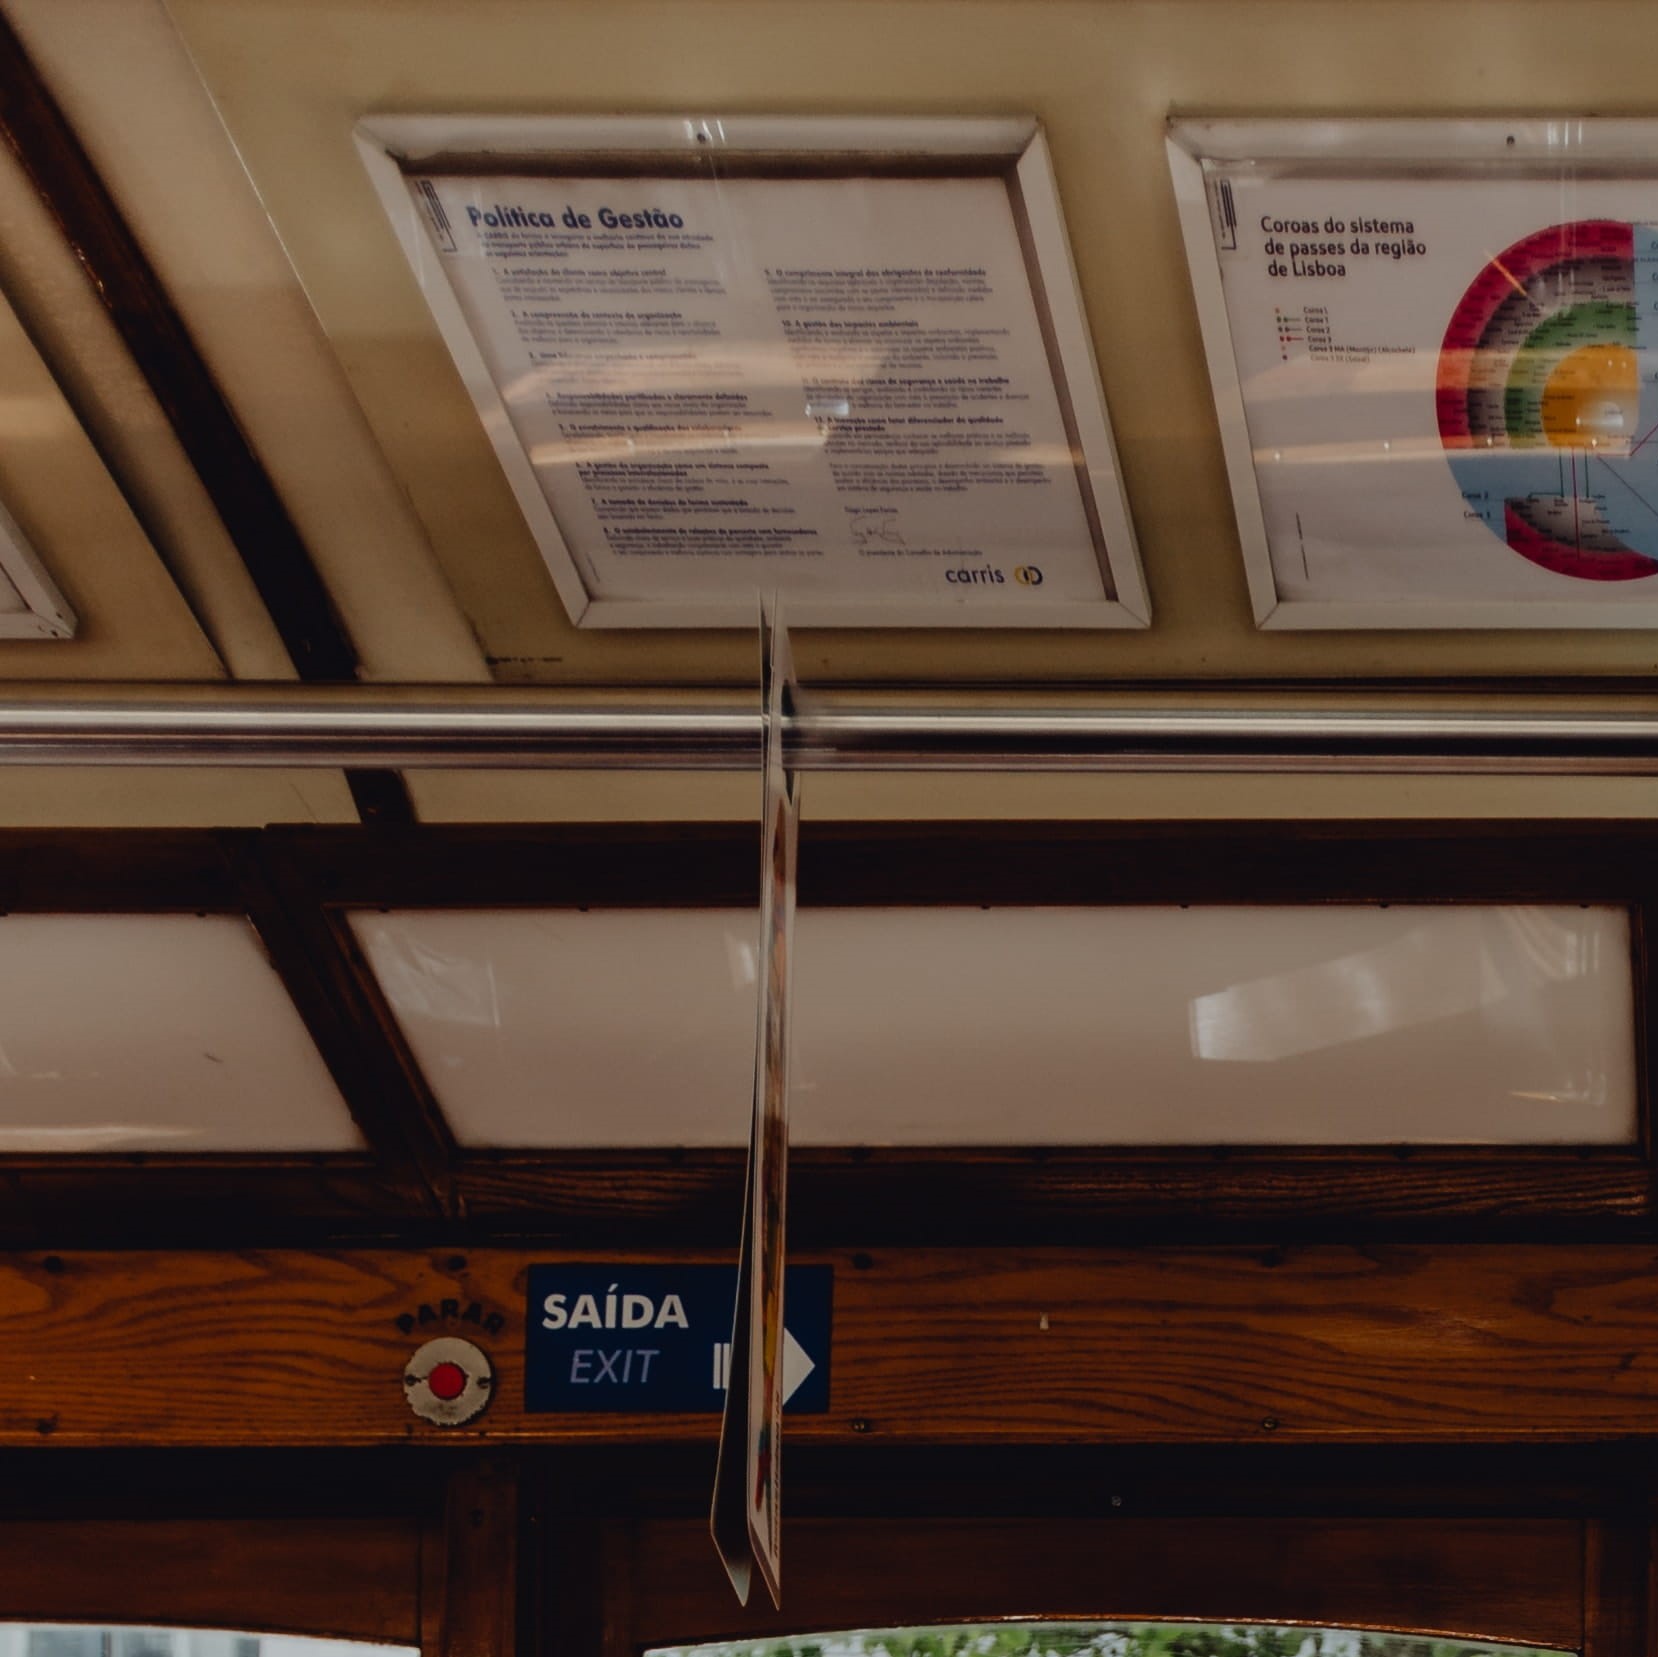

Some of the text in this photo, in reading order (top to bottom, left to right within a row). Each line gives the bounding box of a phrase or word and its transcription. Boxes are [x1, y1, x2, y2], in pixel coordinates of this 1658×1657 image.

[466, 205, 684, 229] Política de Gestão
[1261, 217, 1414, 233] Coroas do sistema
[1264, 239, 1426, 260] de passes da região
[1268, 260, 1346, 276] de Lisboa
[945, 564, 1005, 584] carris
[542, 1284, 689, 1329] SAÍDA
[570, 1349, 660, 1383] EXIT
